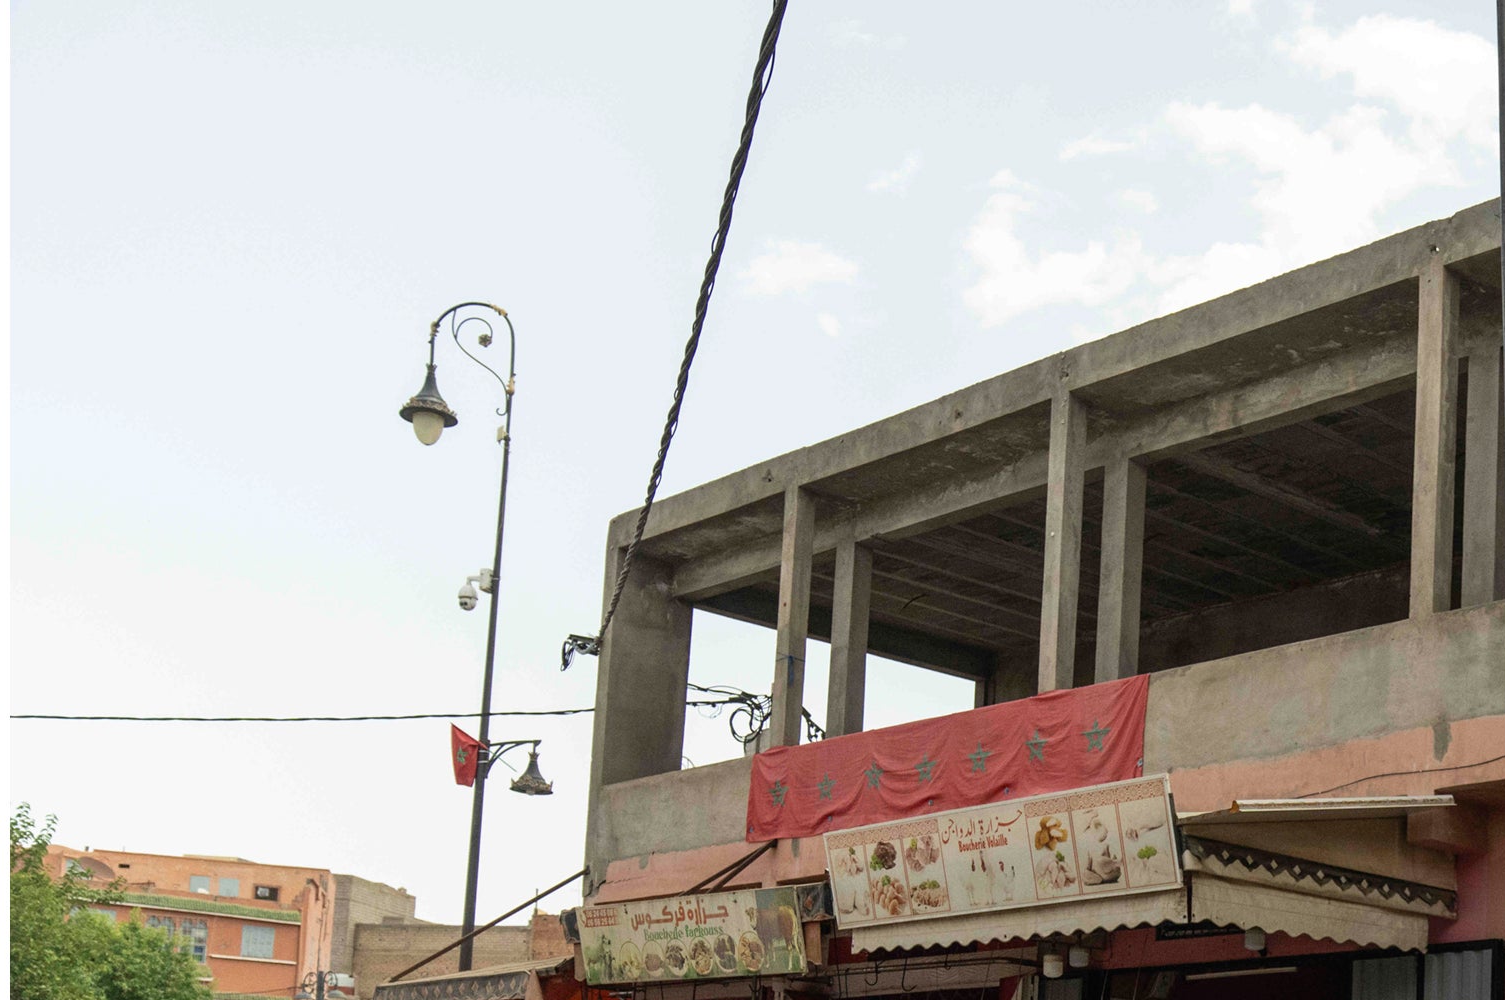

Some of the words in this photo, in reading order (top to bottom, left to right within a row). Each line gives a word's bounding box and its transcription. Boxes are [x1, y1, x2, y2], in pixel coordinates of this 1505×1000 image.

[978, 809, 1023, 835] جزارة
[957, 838, 986, 853] Boucherie
[986, 834, 1008, 849] Volaille
[630, 902, 686, 931] فركوس
[686, 899, 730, 926] جزارة
